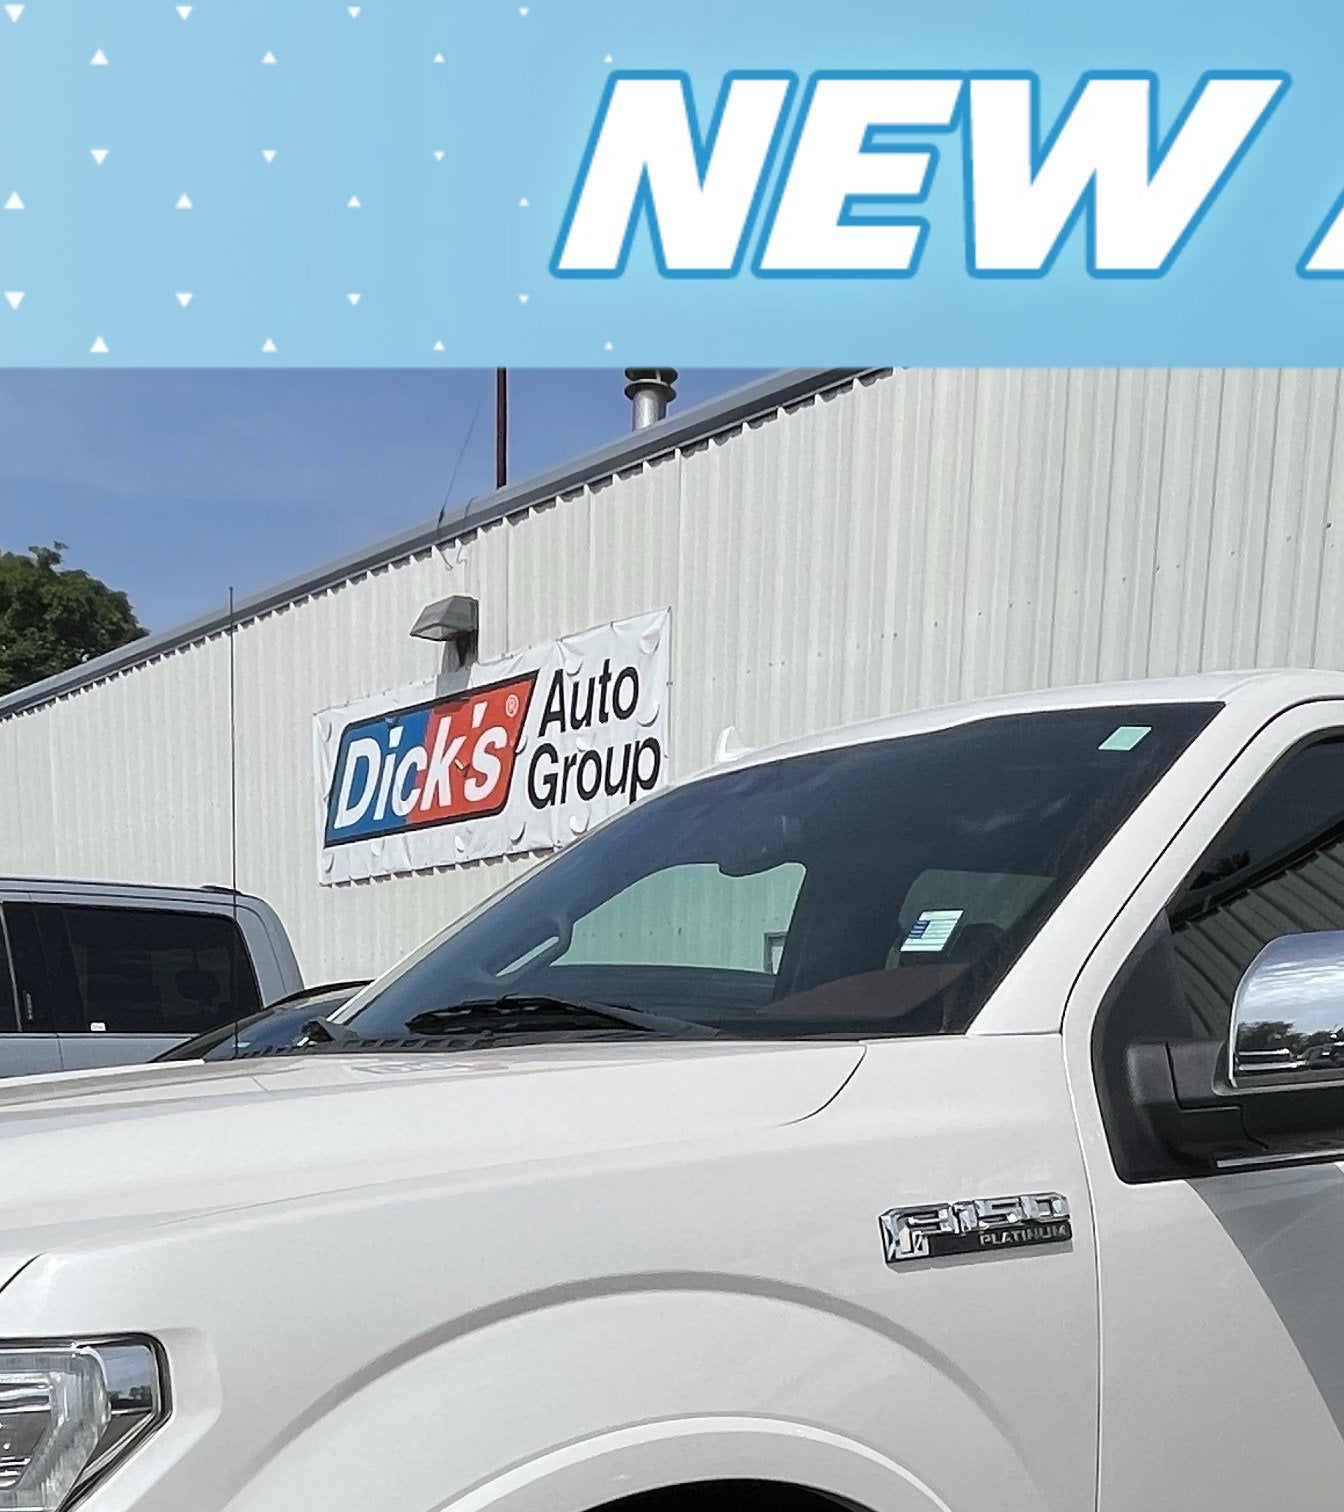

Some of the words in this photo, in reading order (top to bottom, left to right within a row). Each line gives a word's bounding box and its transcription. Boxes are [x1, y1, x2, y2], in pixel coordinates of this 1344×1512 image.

[538, 658, 639, 737] Auto
[334, 702, 509, 830] Dick's
[527, 736, 661, 810] Group
[978, 1224, 1068, 1247] PLATINUM
